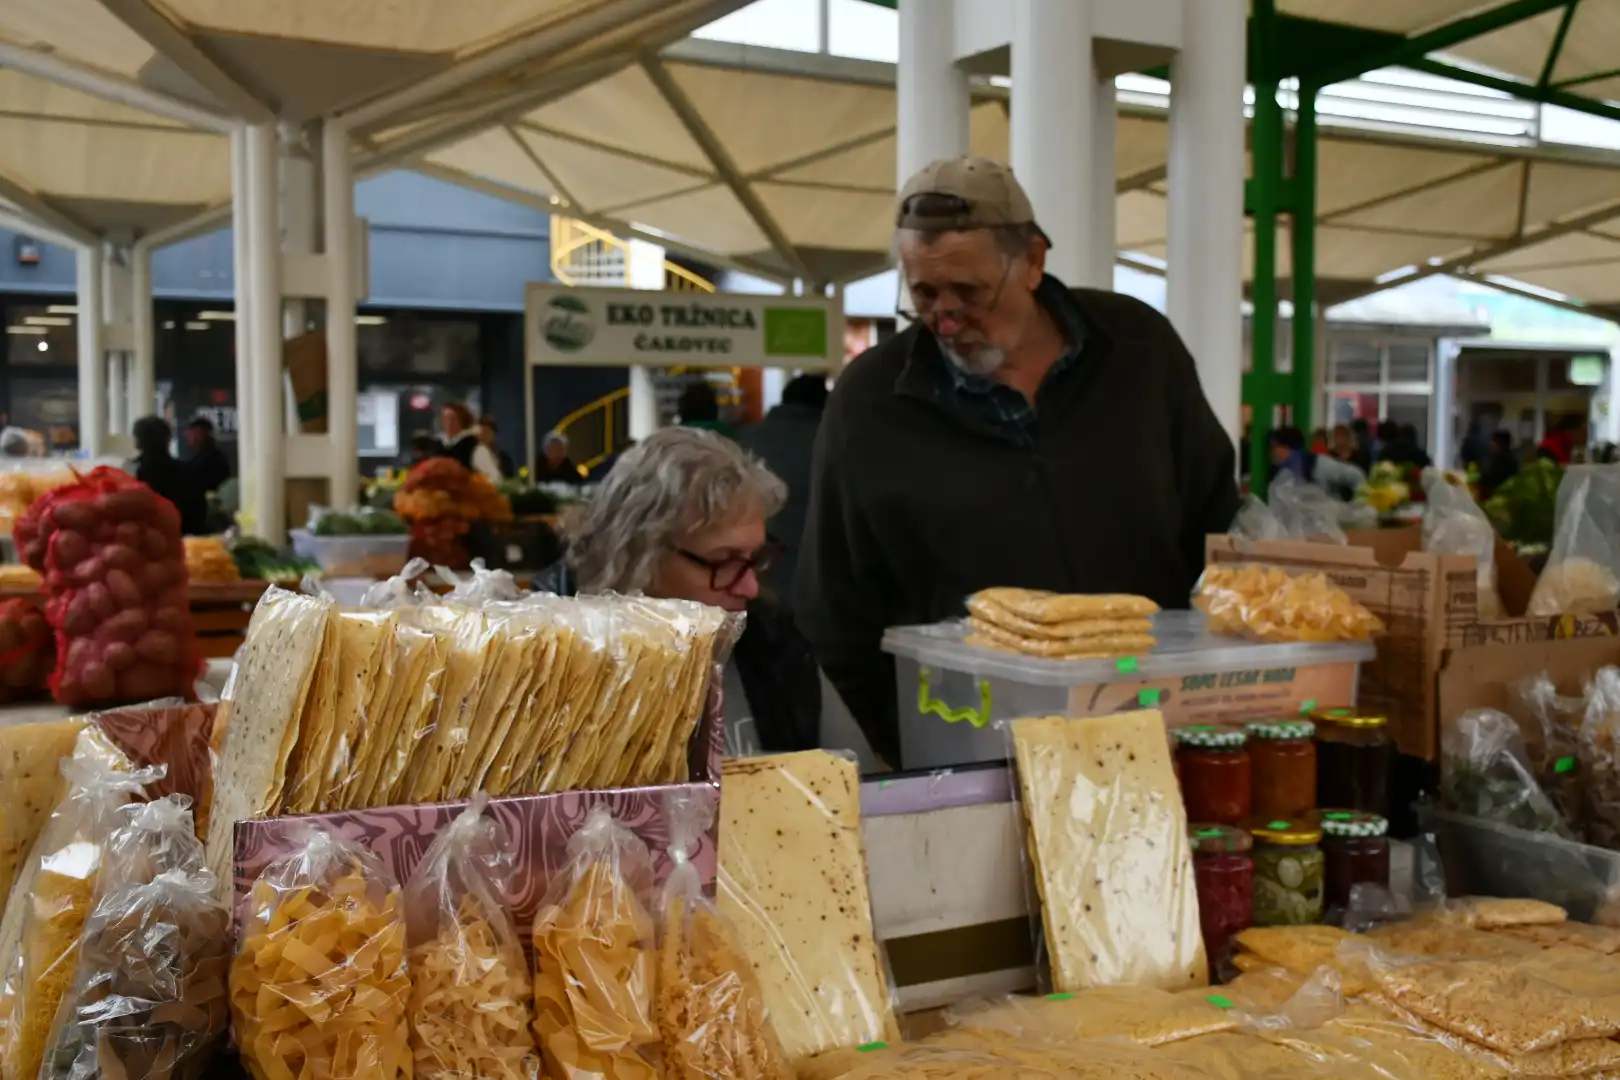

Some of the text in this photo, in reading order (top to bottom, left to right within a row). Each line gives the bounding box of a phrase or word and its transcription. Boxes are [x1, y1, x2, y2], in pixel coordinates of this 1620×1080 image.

[606, 303, 657, 328] EKO
[660, 301, 758, 331] TRŽNICA
[632, 331, 733, 355] ČAKOVEC
